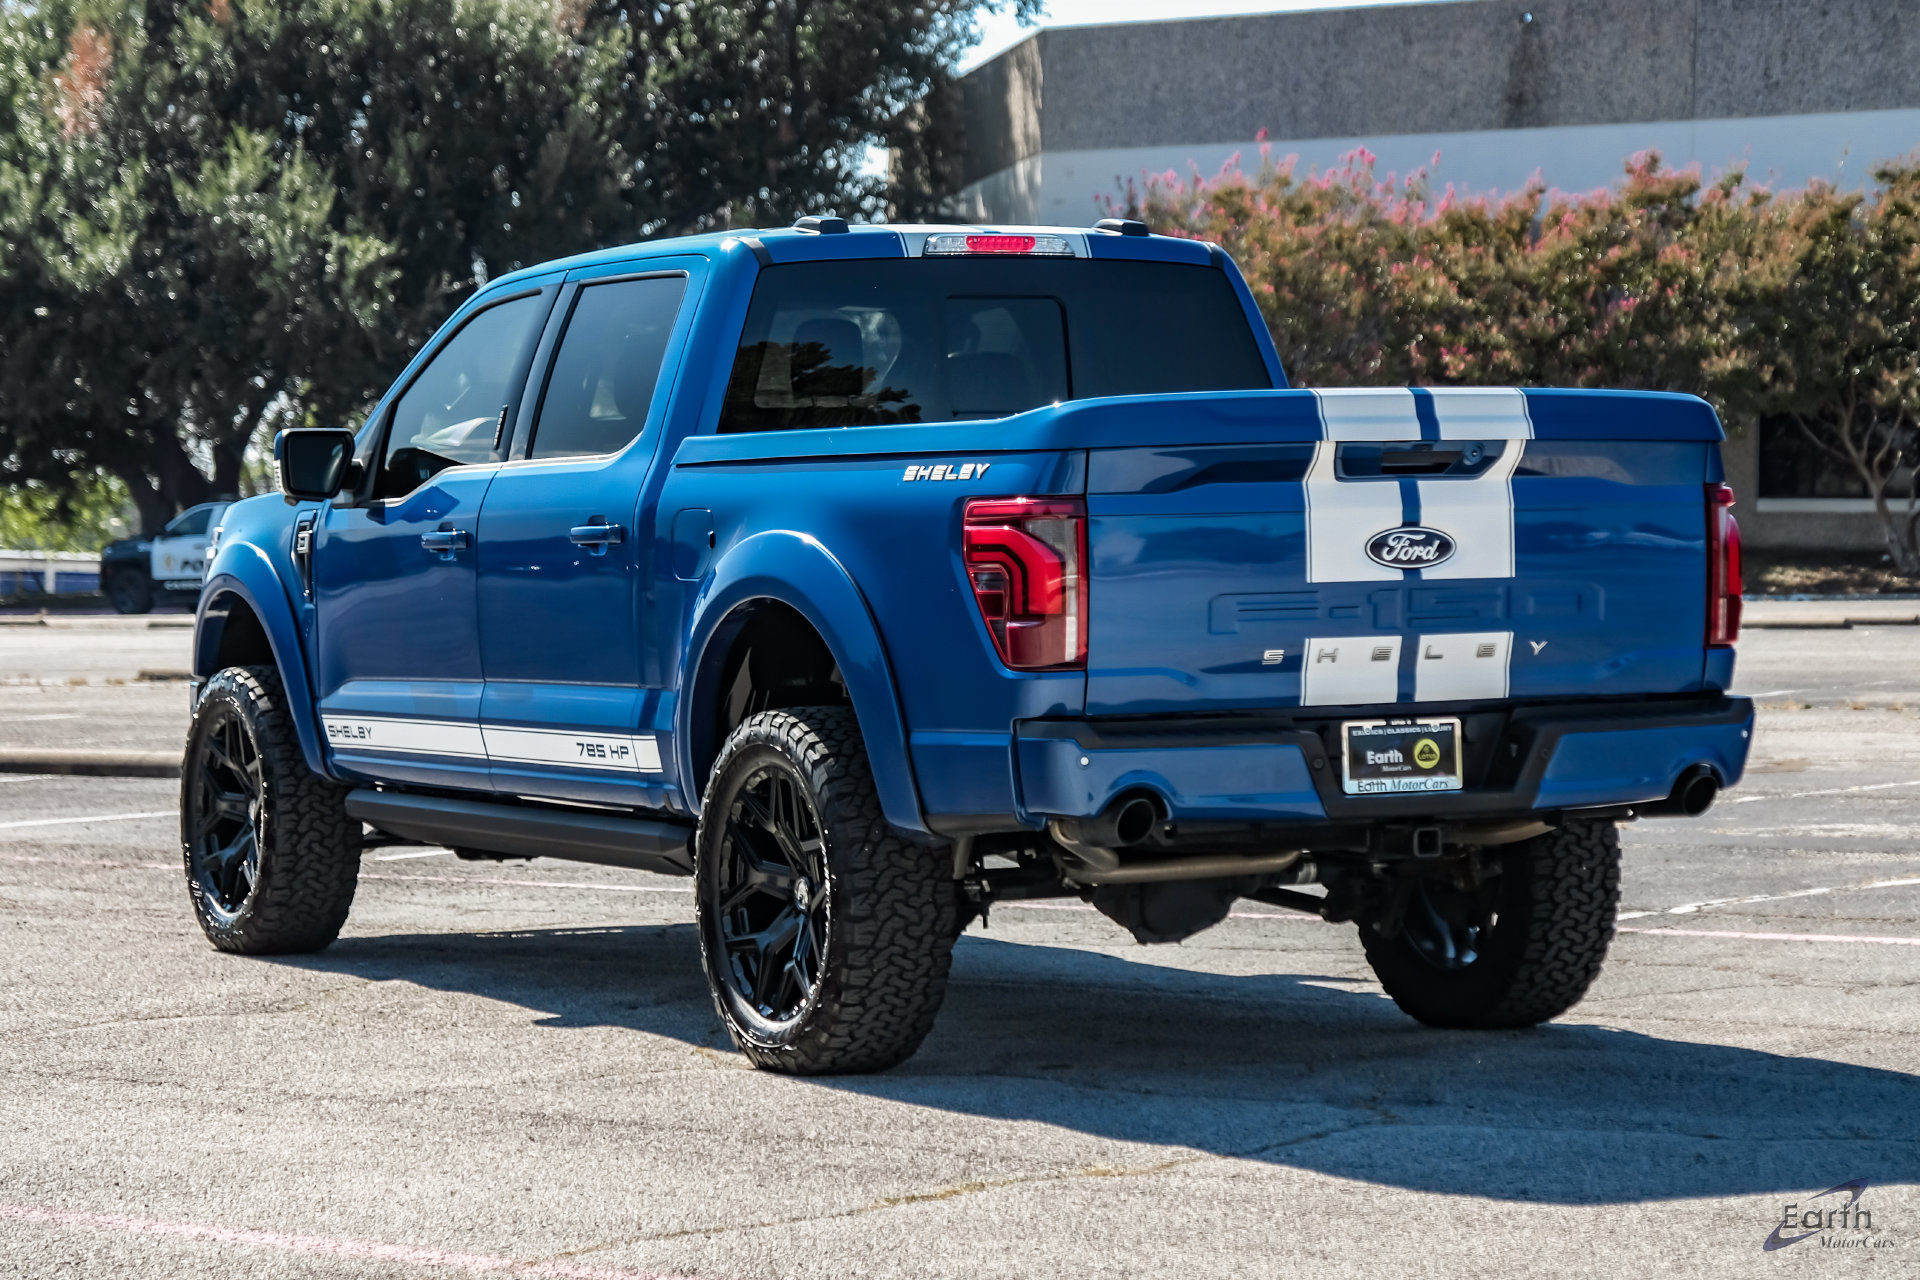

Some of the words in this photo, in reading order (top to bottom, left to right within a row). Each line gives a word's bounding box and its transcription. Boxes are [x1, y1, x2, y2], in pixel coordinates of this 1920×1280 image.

[903, 463, 991, 482] SHELBY
[1382, 533, 1440, 561] Ford
[1208, 584, 1605, 635] F-150
[1261, 640, 1548, 665] SHELBY
[328, 725, 372, 739] SHELBY
[576, 742, 606, 758] 785
[609, 745, 629, 760] HP
[1366, 749, 1404, 765] Earth
[1358, 780, 1388, 793] Earth
[1391, 778, 1449, 792] MotorCars
